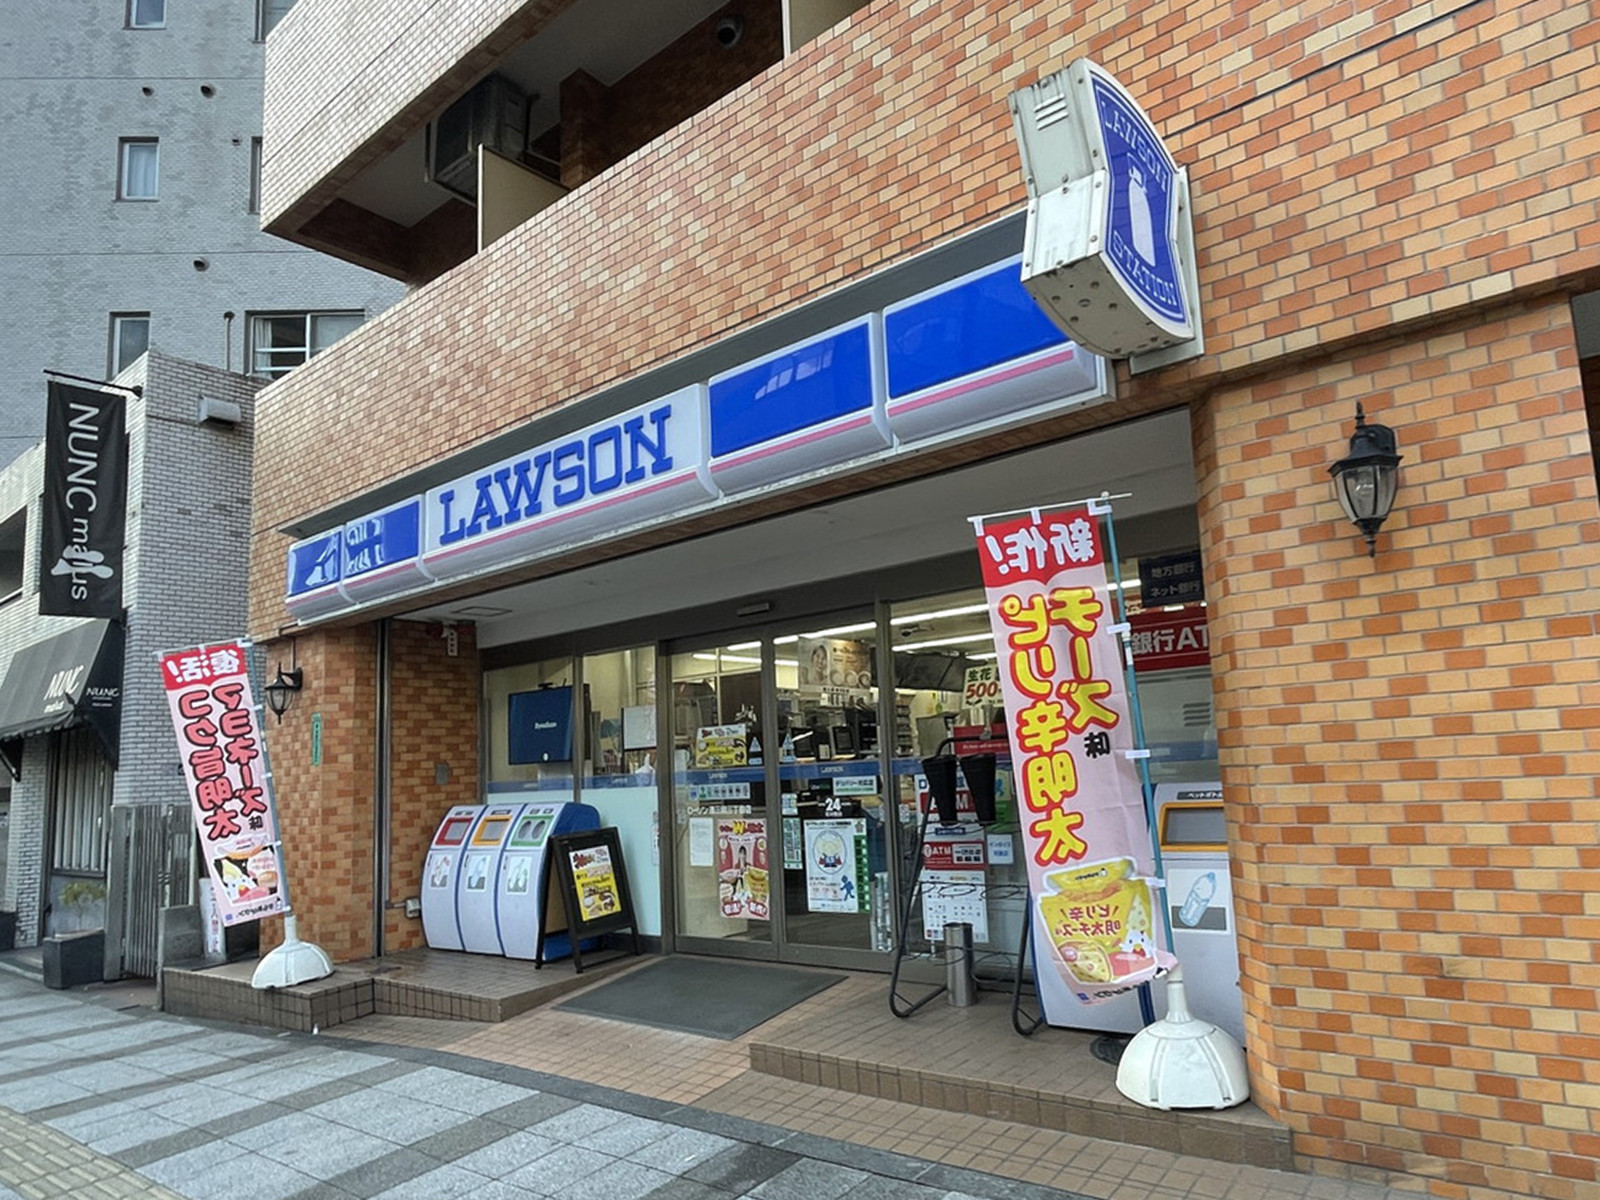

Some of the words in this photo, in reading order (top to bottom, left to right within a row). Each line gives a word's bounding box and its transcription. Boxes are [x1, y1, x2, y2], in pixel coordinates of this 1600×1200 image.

[1113, 230, 1177, 306] STATION
[66, 403, 99, 512] NUNC
[439, 404, 673, 546] LAWSON
[86, 687, 119, 697] NUNC
[825, 798, 841, 811] 24
[932, 846, 951, 855] ATM
